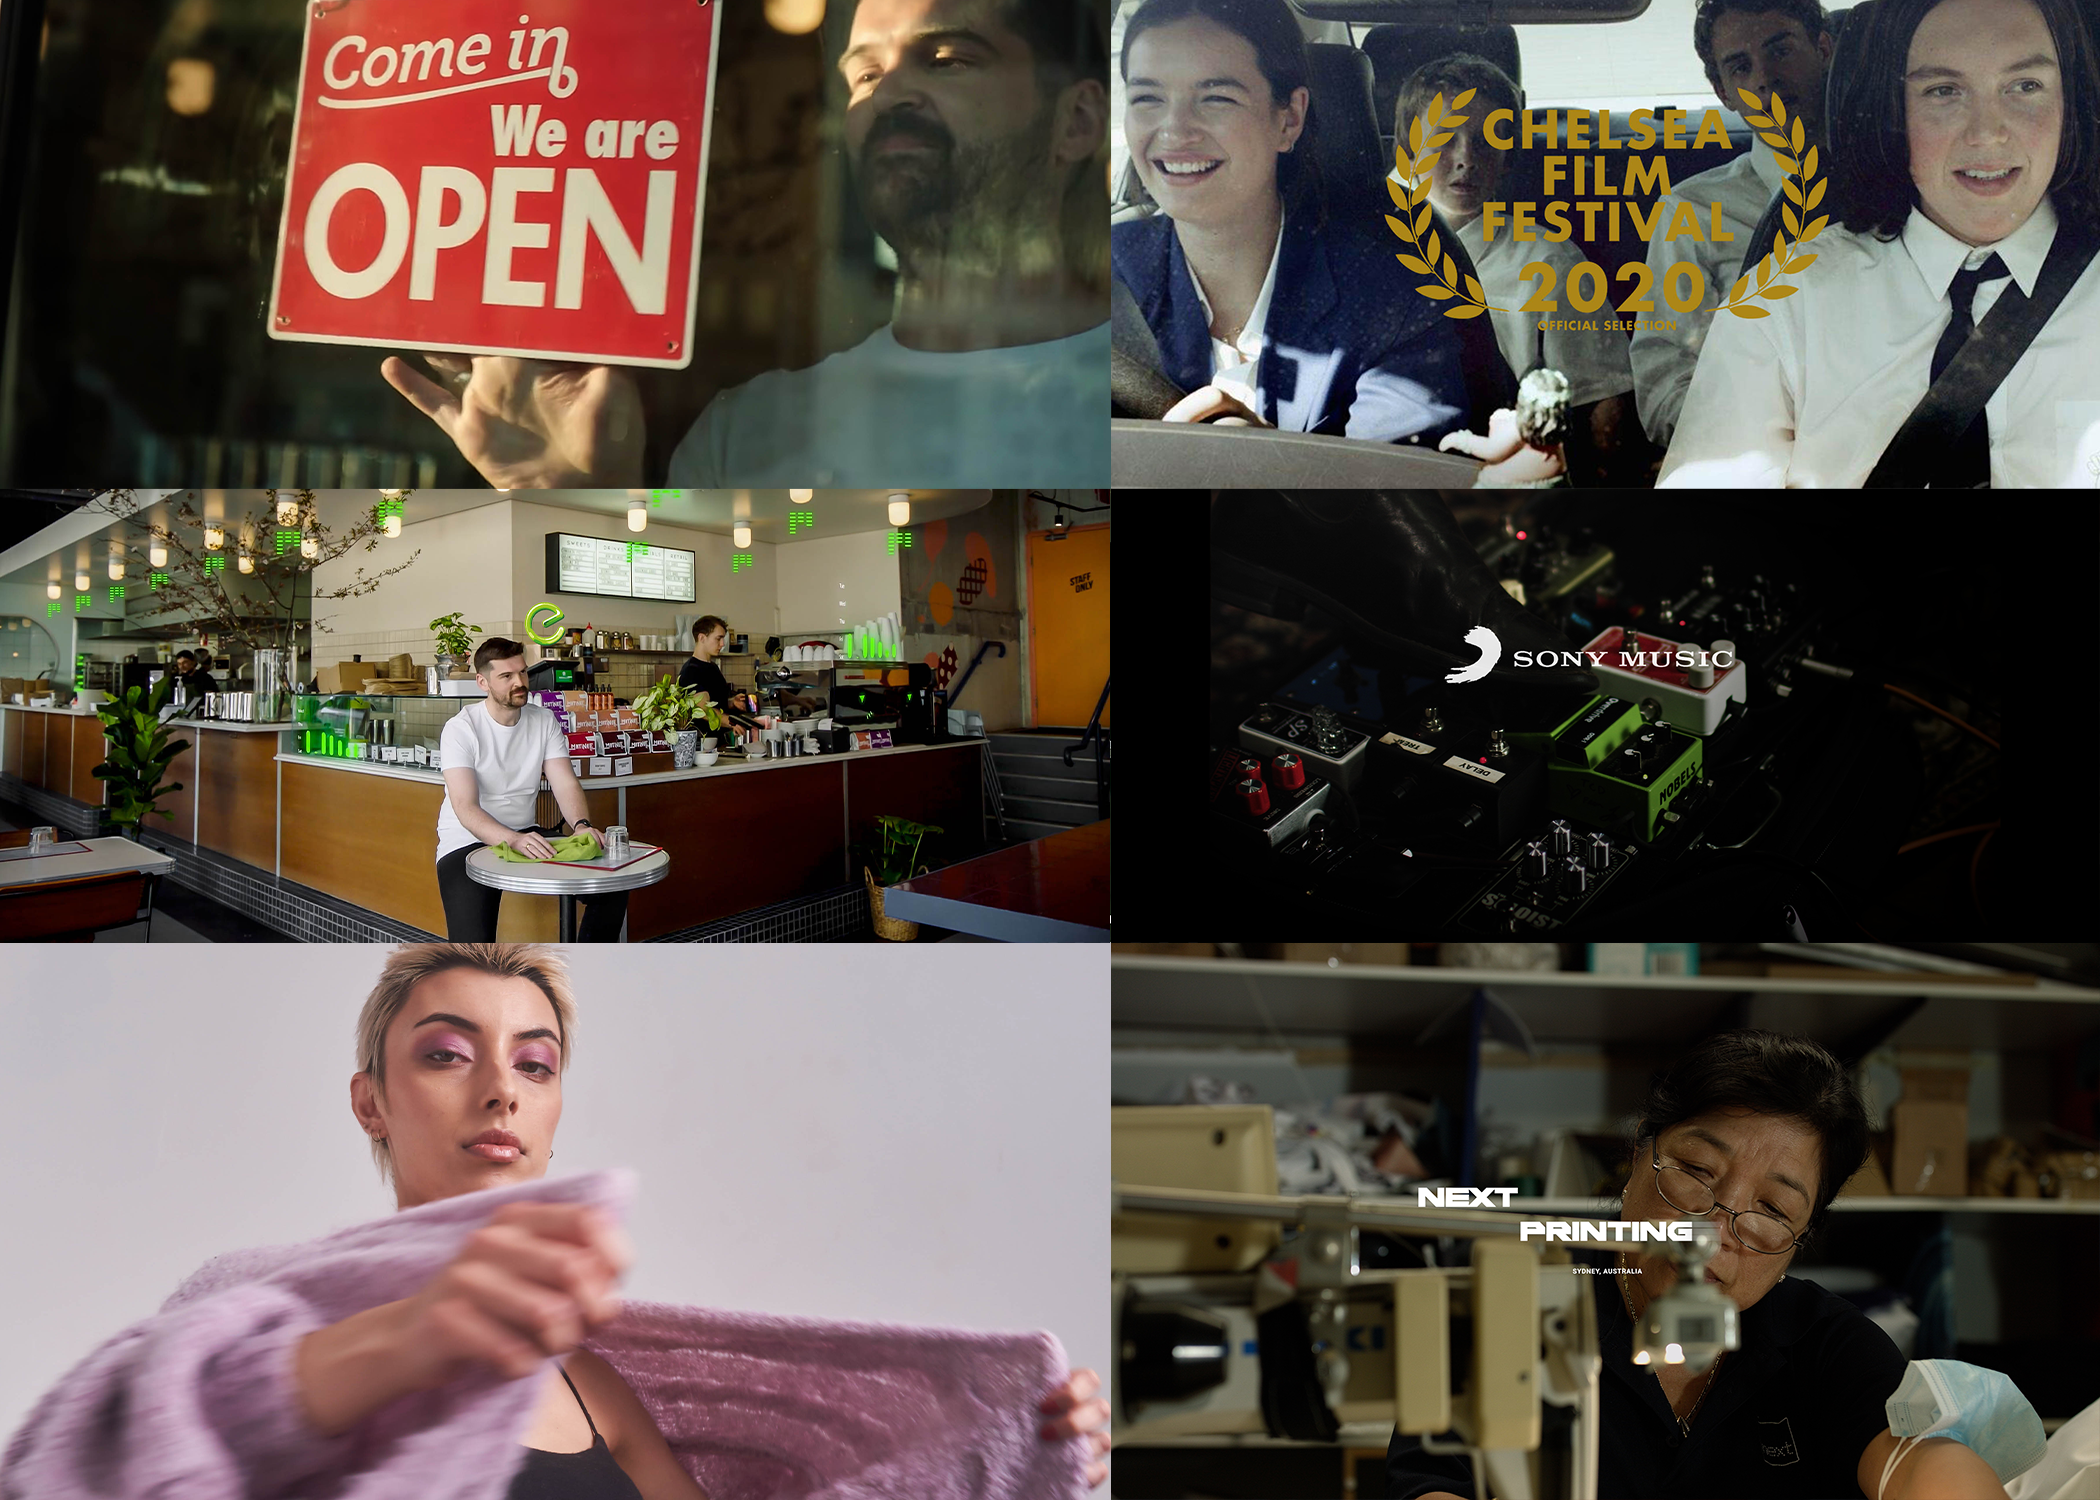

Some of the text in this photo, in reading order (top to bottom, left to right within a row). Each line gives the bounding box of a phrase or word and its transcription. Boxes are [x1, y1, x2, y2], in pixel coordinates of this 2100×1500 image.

[323, 15, 579, 99] Come in
[490, 104, 680, 161] We are
[303, 162, 677, 315] OPEN
[1070, 571, 1091, 586] STAFF
[1075, 580, 1094, 593] ONLY
[1584, 697, 1620, 723] Overdrive
[1287, 718, 1309, 738] SP
[1459, 762, 1491, 777] DELAY
[1659, 762, 1696, 805] NOBELS
[1481, 893, 1563, 931] SOIST
